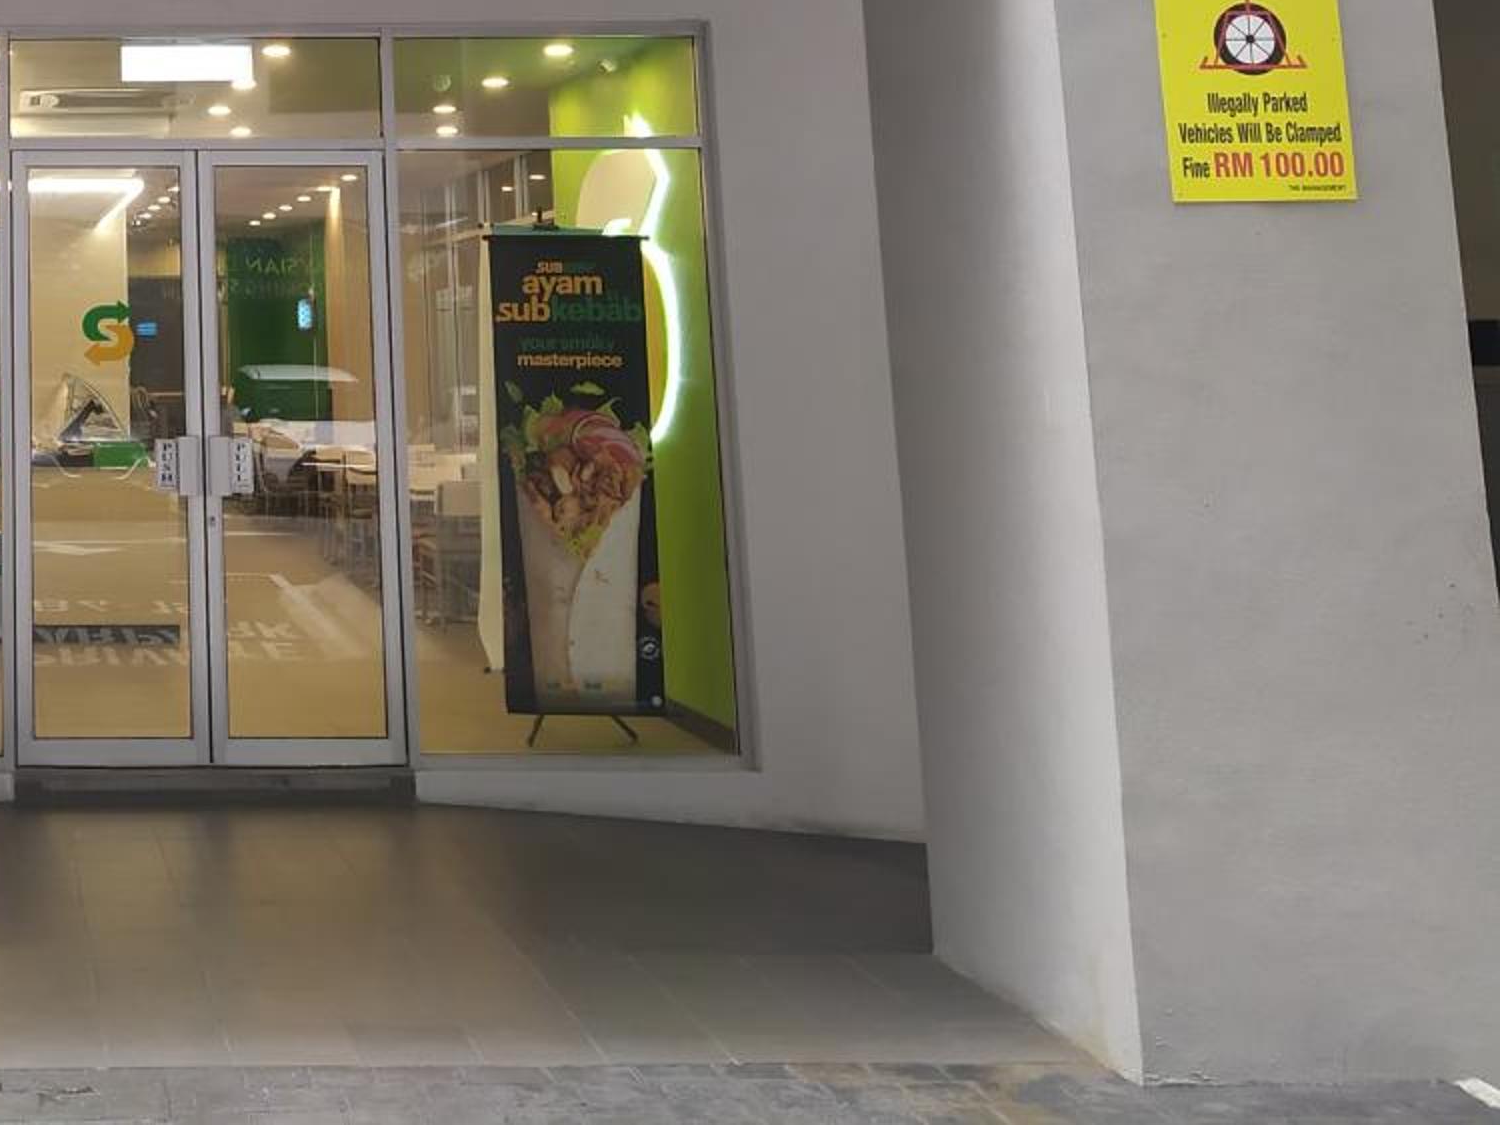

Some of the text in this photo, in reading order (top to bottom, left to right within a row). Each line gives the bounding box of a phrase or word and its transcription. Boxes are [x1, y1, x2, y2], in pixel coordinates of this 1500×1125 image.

[1207, 92, 1308, 117] Illegally Parked
[1178, 121, 1342, 147] Vehicles Will Be Clamped
[1182, 151, 1345, 178] Fine RM 100.00
[521, 274, 604, 300] ayam
[516, 351, 623, 370] masterpiece
